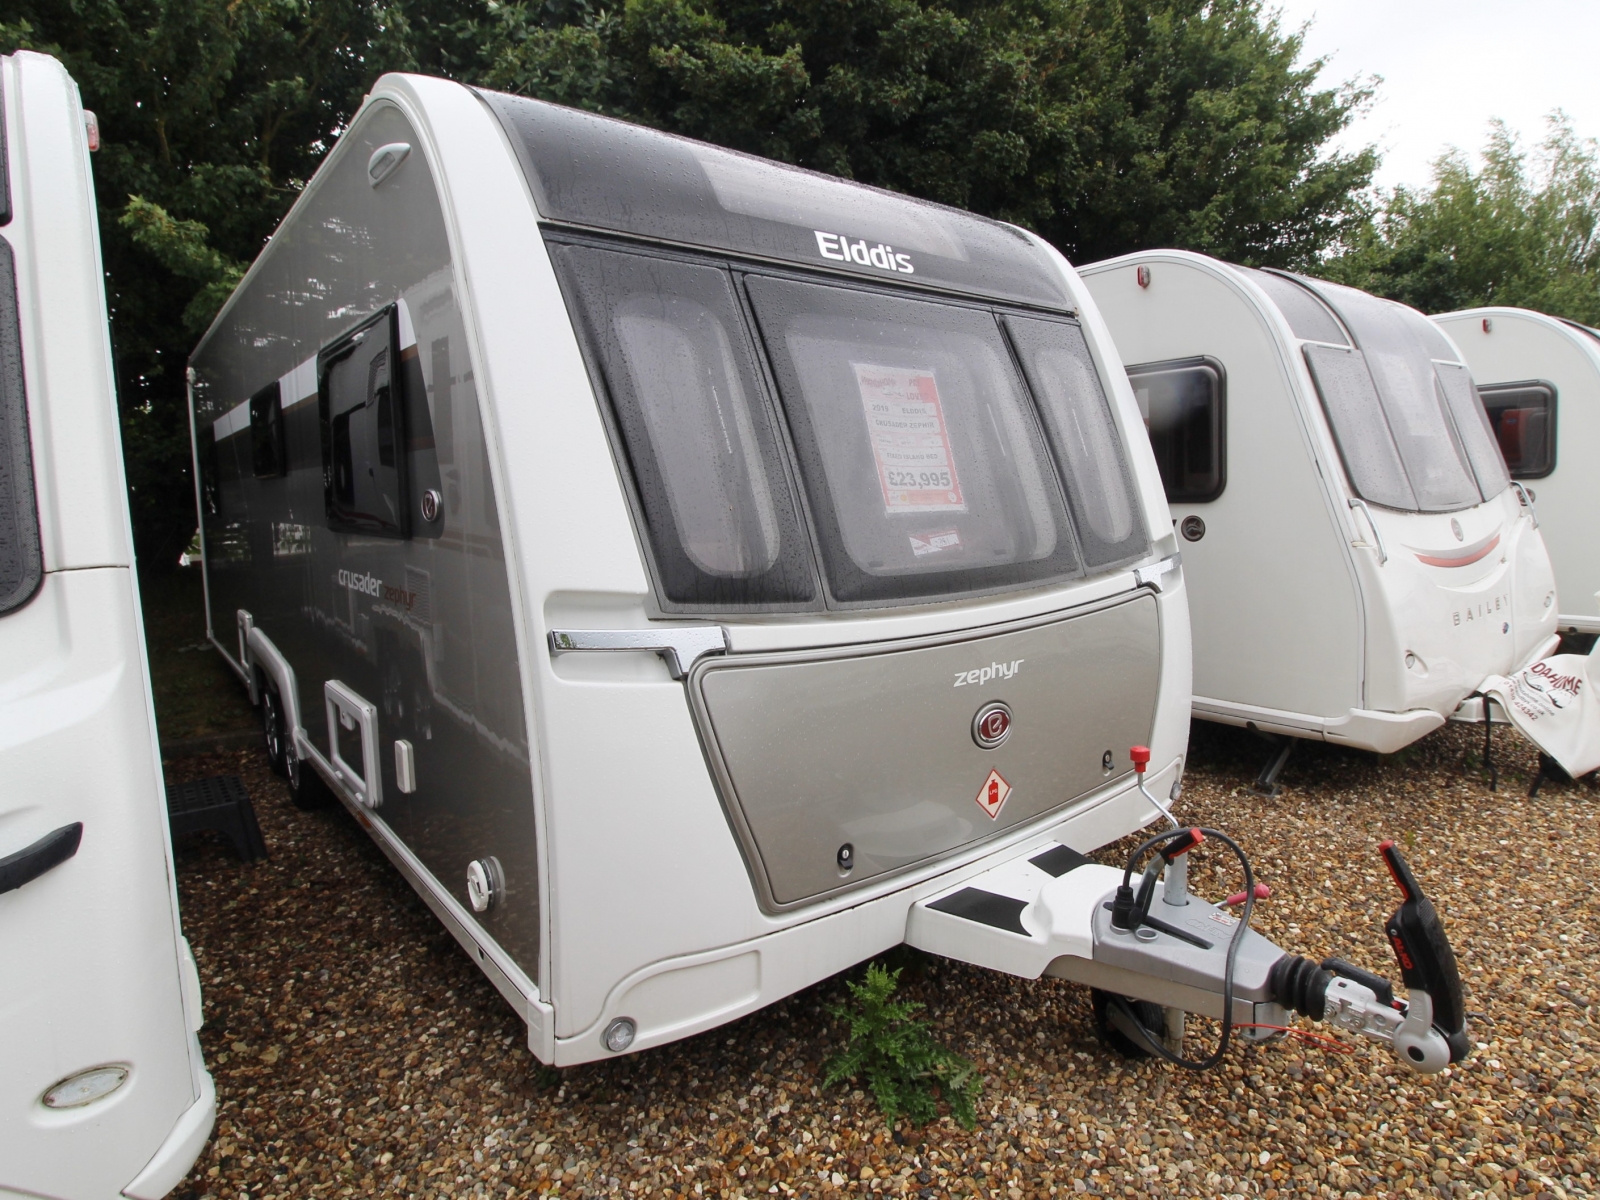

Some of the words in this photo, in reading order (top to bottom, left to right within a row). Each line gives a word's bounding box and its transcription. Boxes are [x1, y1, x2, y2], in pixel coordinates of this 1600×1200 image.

[813, 230, 914, 274] Elddis
[872, 404, 889, 412] 2019
[888, 471, 951, 489] £23,995
[338, 569, 382, 597] crusader
[384, 584, 417, 611] zephyr
[1453, 594, 1508, 627] BAILEY
[953, 659, 1025, 687] zephyr
